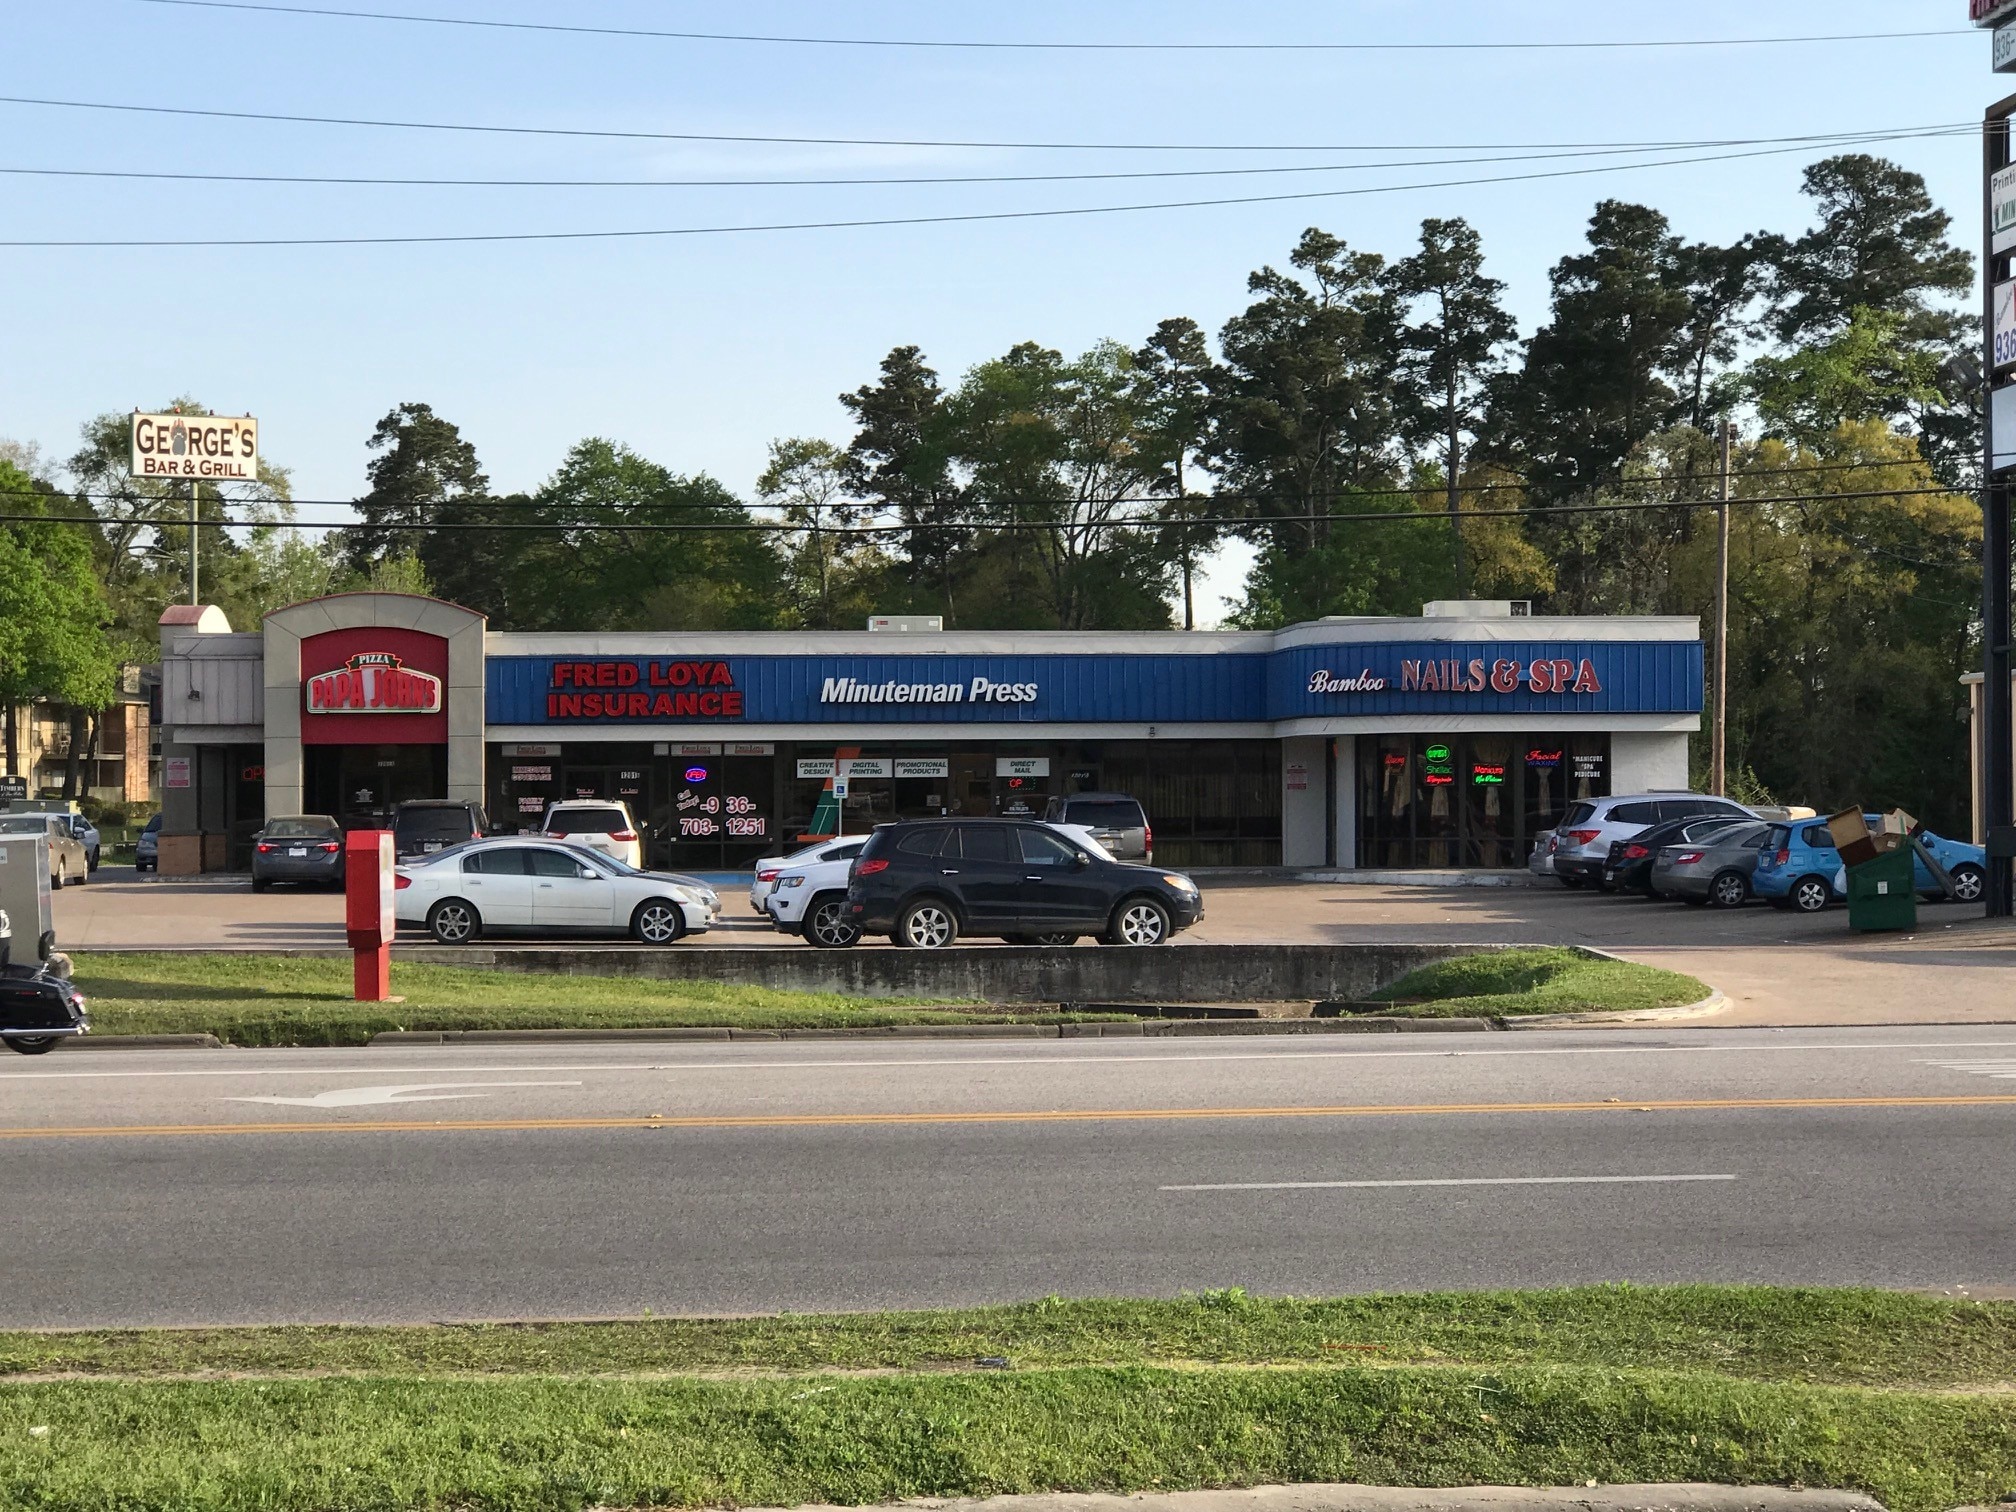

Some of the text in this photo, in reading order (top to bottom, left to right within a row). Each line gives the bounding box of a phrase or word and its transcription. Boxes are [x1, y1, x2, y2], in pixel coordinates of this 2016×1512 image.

[136, 418, 254, 458] GERGE'S
[144, 457, 247, 477] BAR & GRILL
[358, 654, 390, 664] PIZZA
[554, 662, 733, 686] FRED LOYA
[1307, 658, 1602, 693] Bamboo NAILS & SPA
[312, 670, 365, 708] PAPA
[820, 677, 1038, 703] Minuteman Press
[548, 692, 742, 717] INSURANCE
[799, 761, 834, 769] CREATIVE
[852, 761, 880, 769] DIGITAL
[896, 761, 947, 769] PROMOTIONAL
[1010, 760, 1037, 768] DIRECT
[726, 818, 765, 835] 1251
